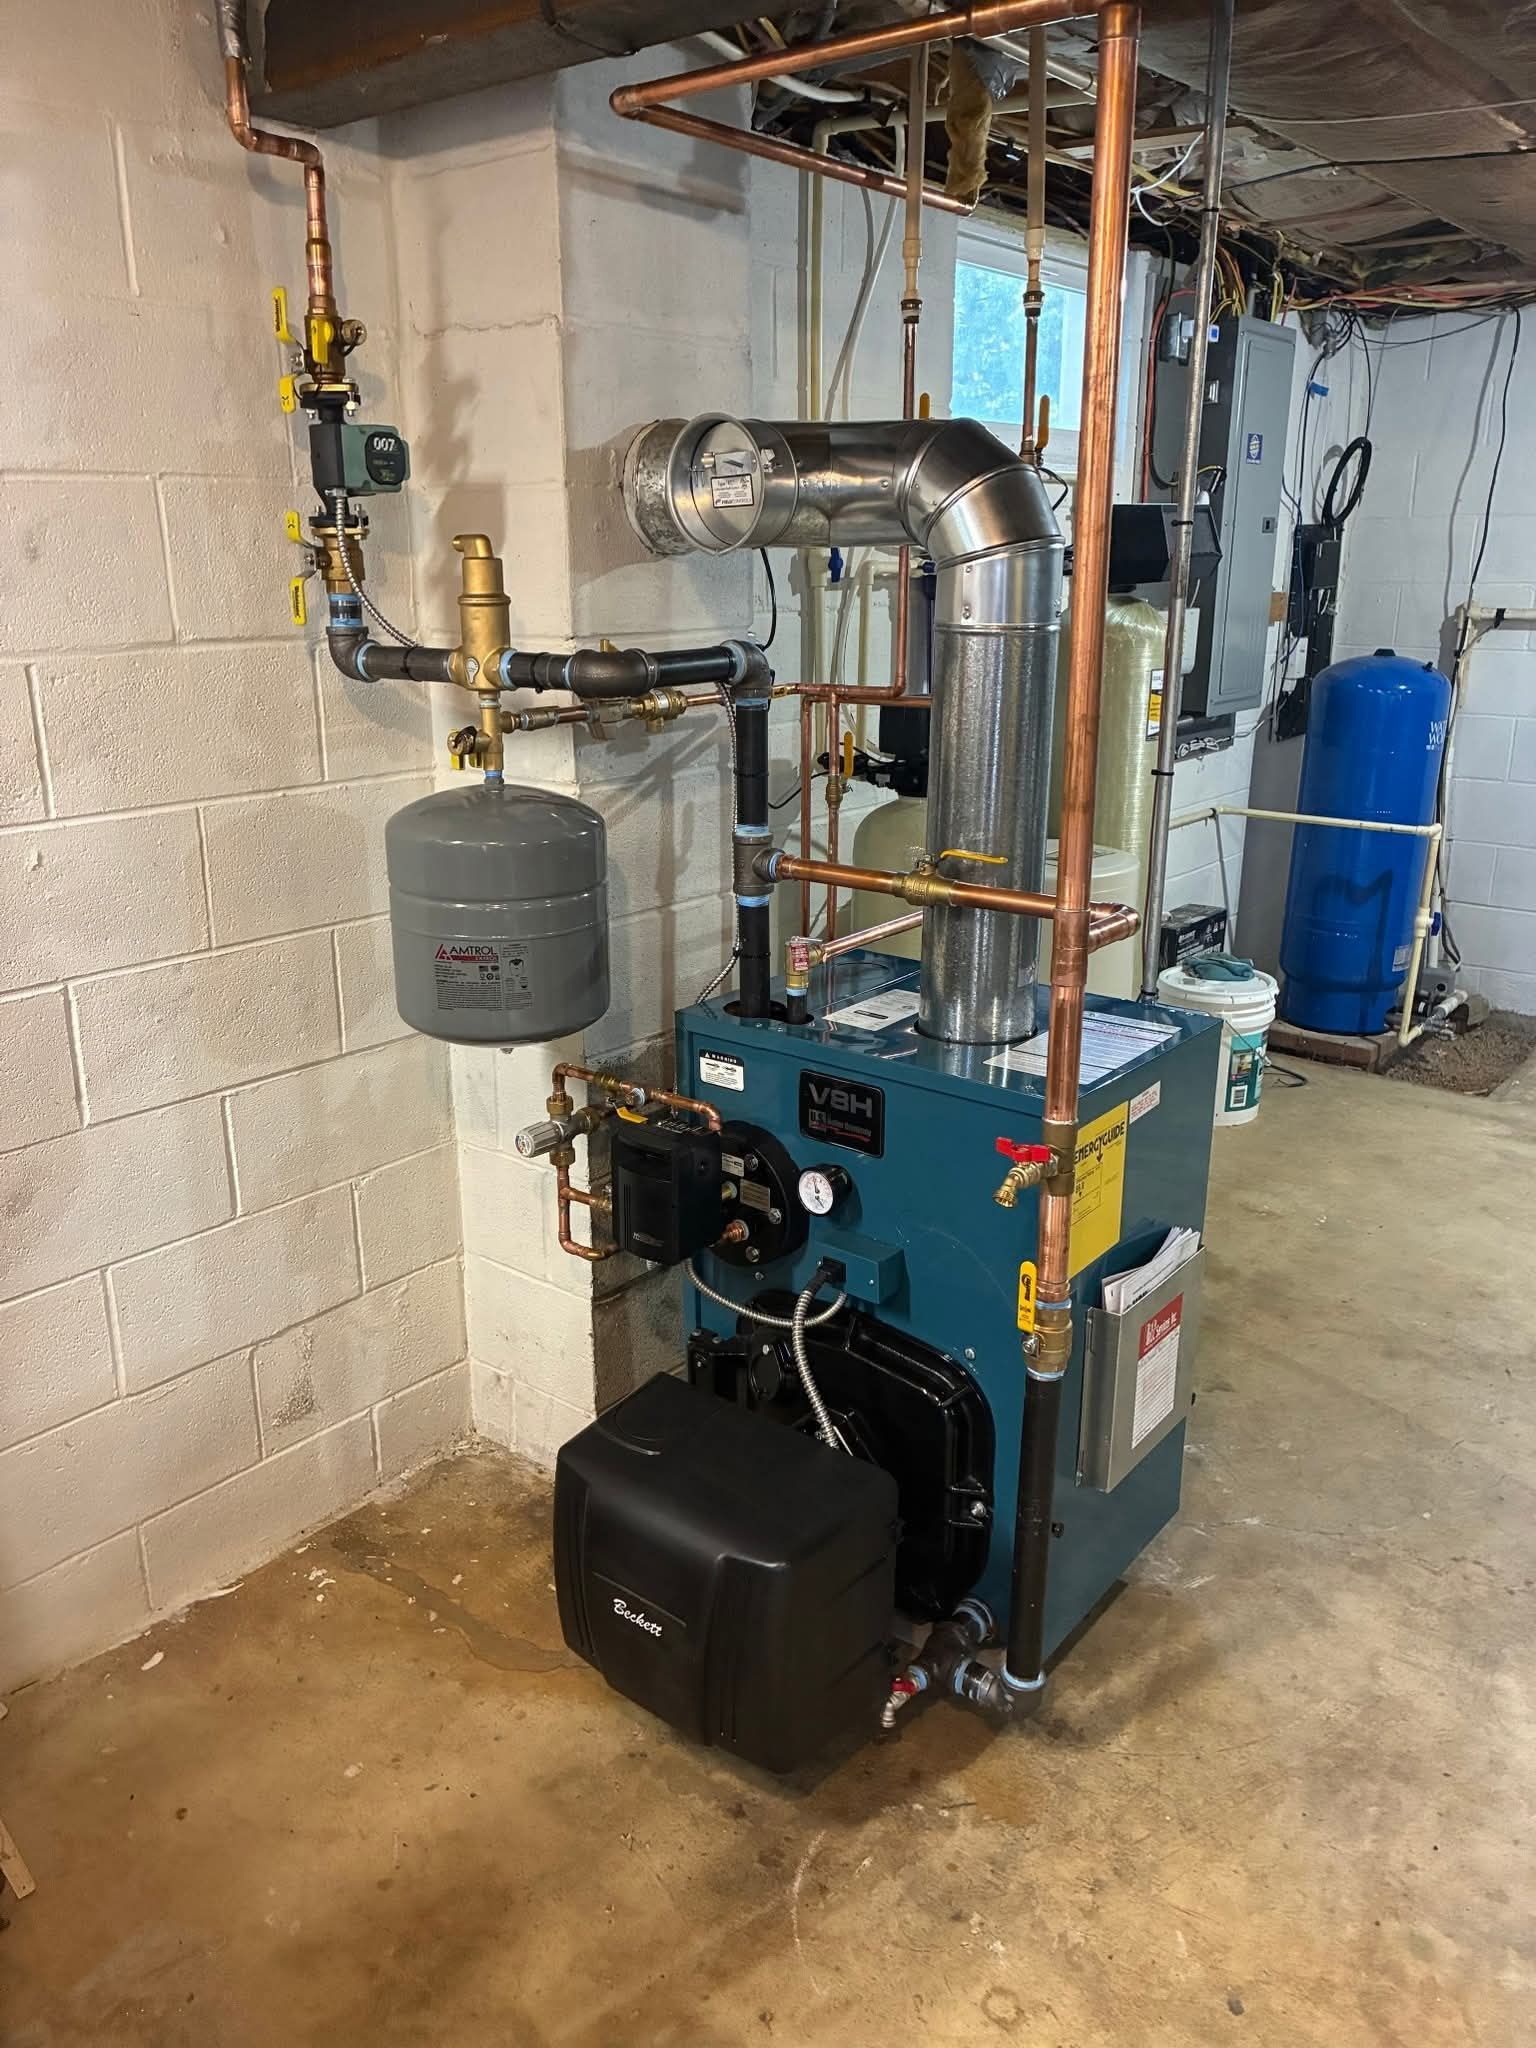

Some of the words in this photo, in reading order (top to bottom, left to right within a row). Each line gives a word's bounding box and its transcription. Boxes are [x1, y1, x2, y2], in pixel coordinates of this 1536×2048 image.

[373, 437, 396, 452] 007
[449, 945, 498, 956] AMTROL
[808, 1082, 873, 1119] V8H
[1074, 1119, 1126, 1165] ENERGYGUIDE
[613, 1598, 663, 1637] Beckett
